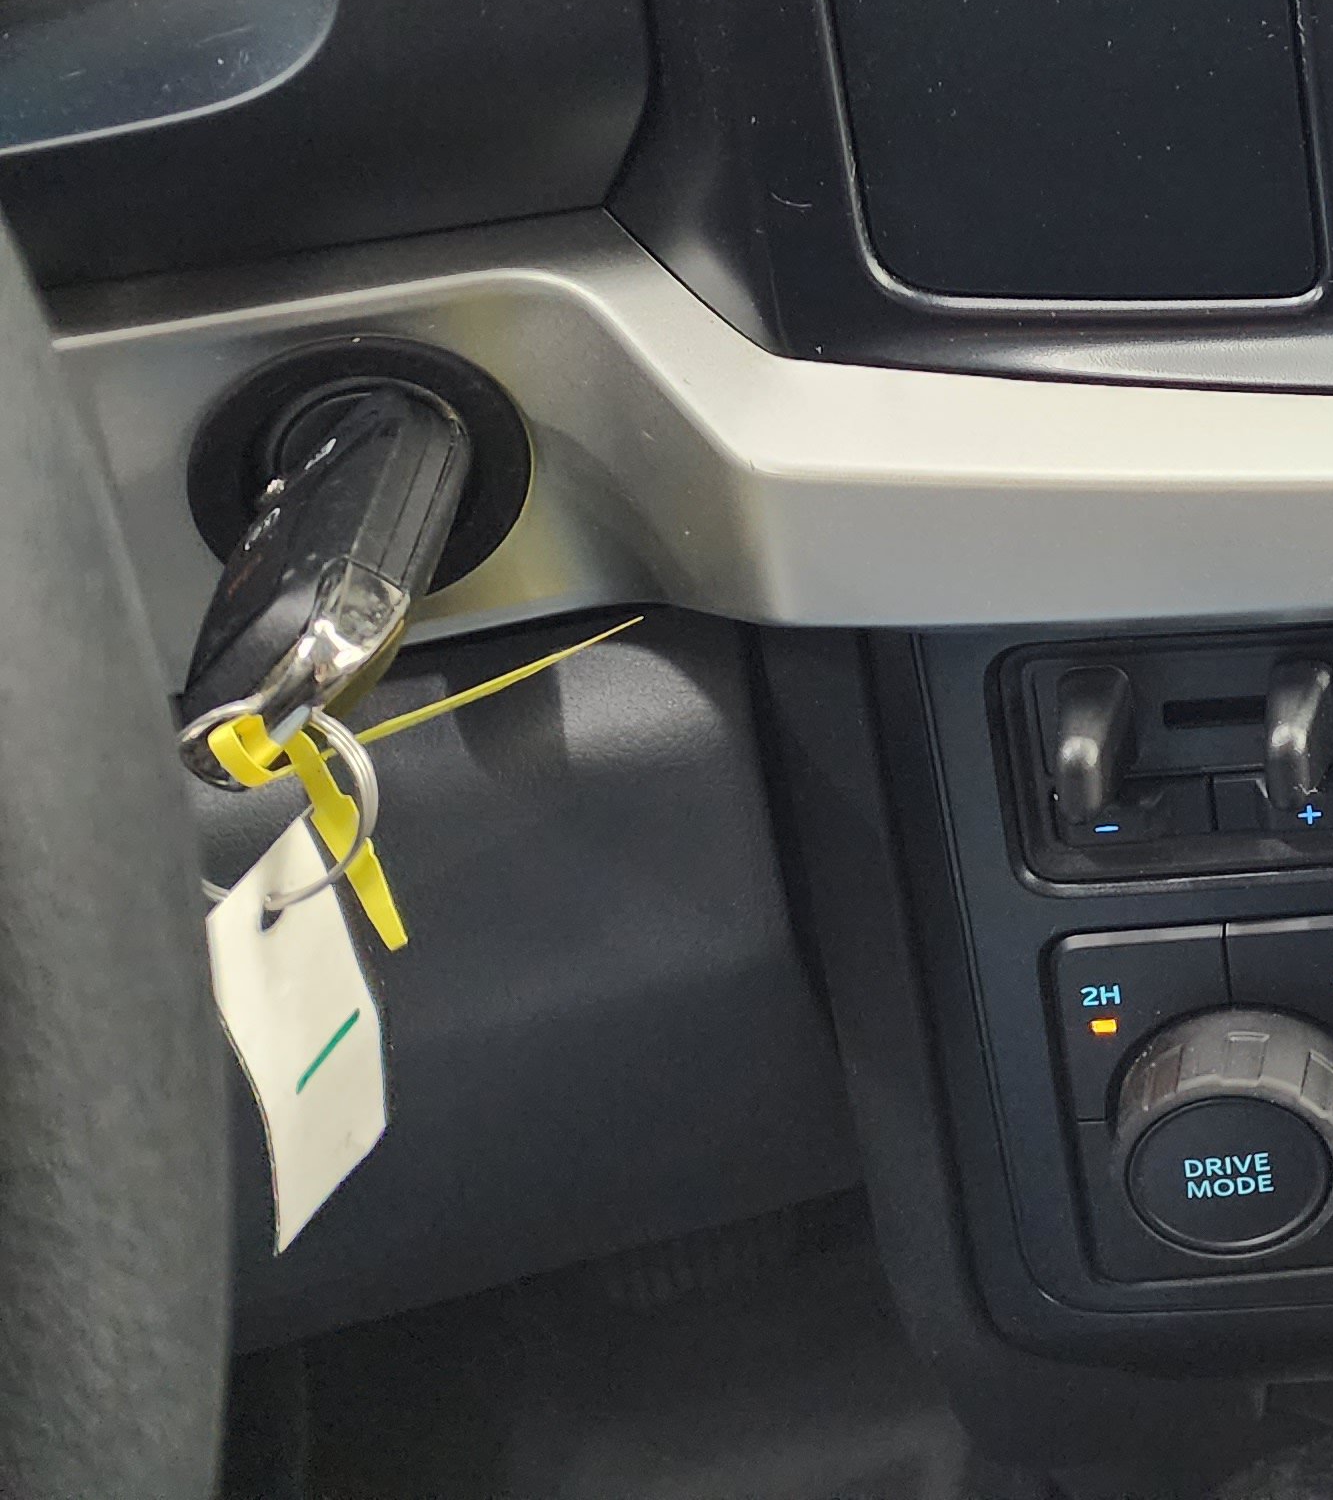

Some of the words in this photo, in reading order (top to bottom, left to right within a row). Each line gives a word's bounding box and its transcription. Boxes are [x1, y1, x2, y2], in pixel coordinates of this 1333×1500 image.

[1079, 984, 1122, 1007] 2H
[1183, 1152, 1271, 1178] DRIVE
[1186, 1173, 1275, 1200] MODE
